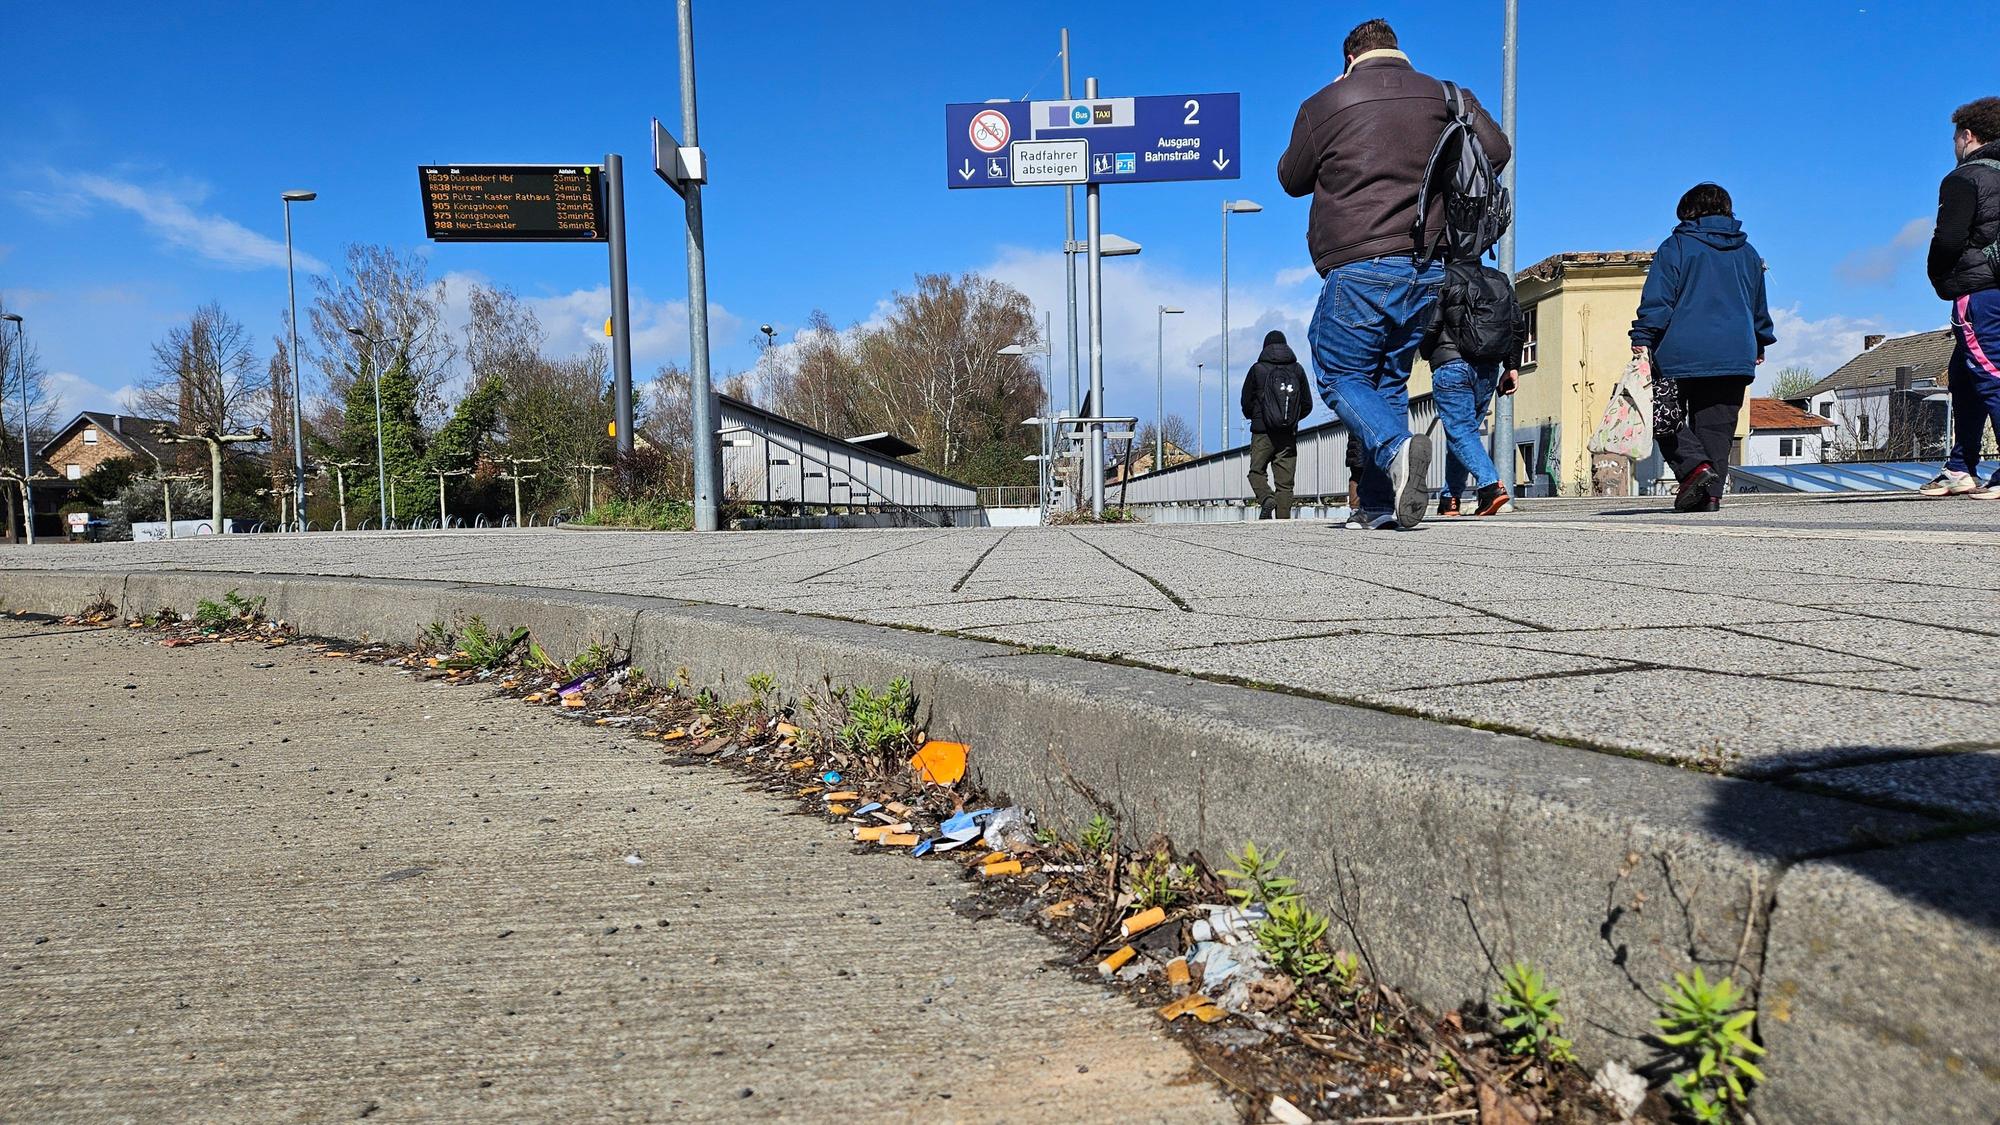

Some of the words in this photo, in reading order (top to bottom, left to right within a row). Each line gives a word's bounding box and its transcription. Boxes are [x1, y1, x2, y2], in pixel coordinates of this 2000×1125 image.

[1075, 111, 1088, 119] Bus
[1095, 110, 1111, 119] TAXI
[1183, 99, 1200, 125] 2
[1157, 137, 1201, 148] Ausgang
[1020, 150, 1078, 161] Radfahrer
[1144, 150, 1201, 162] Bahnstraße
[1022, 164, 1078, 176] absteigen
[499, 174, 514, 183] Hbf
[515, 193, 551, 201] Rathaus
[432, 202, 451, 210] 905
